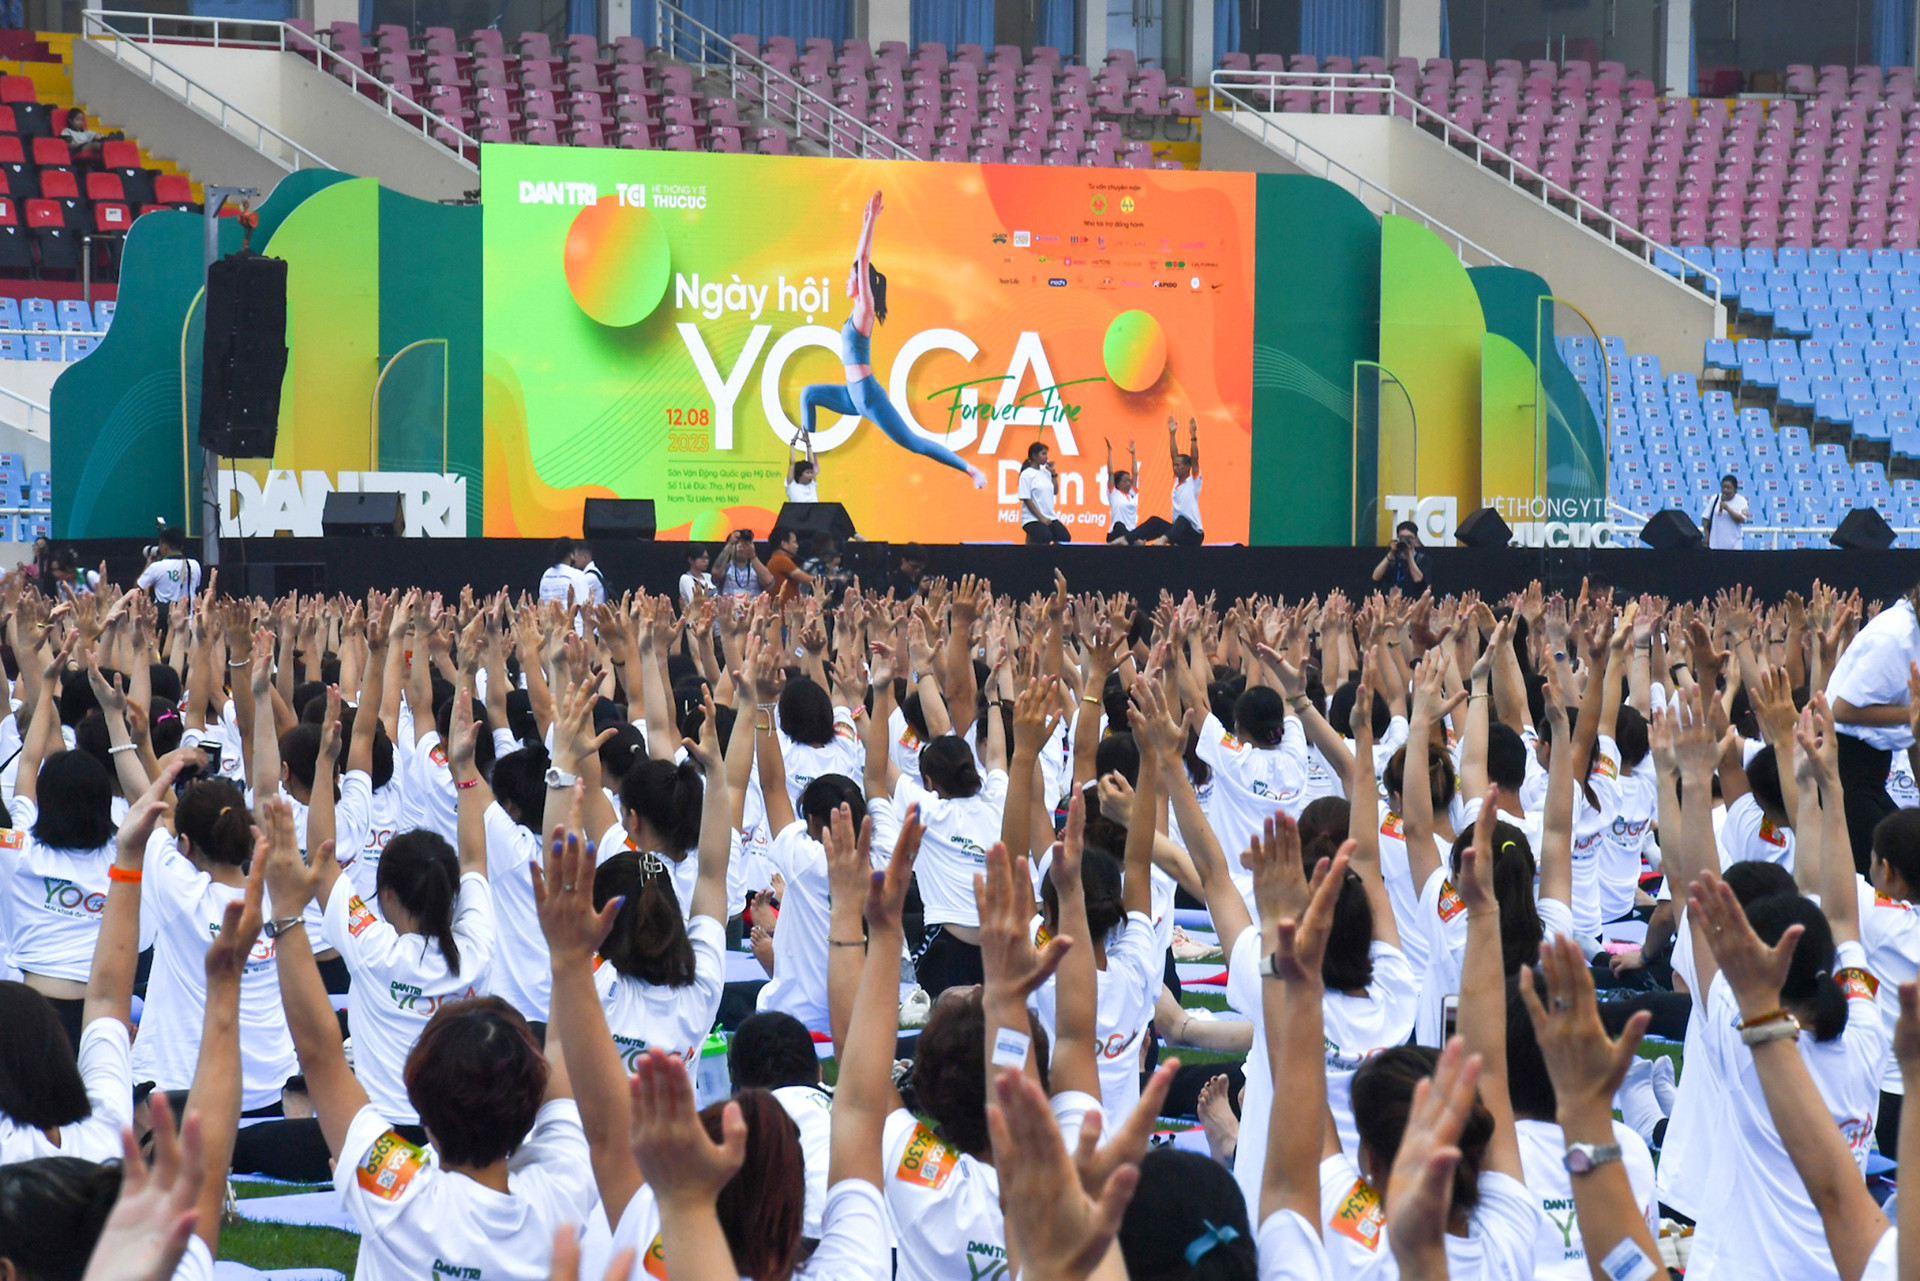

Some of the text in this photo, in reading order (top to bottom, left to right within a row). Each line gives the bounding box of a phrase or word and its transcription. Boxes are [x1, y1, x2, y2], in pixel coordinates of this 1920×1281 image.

[616, 183, 645, 207] TCI
[675, 273, 830, 324] Ngày hội
[666, 407, 710, 427] 12.08
[927, 375, 1107, 443] Forever Fine
[668, 433, 710, 453] 2023
[997, 459, 1085, 506] Dn
[1077, 509, 1106, 528] cùng
